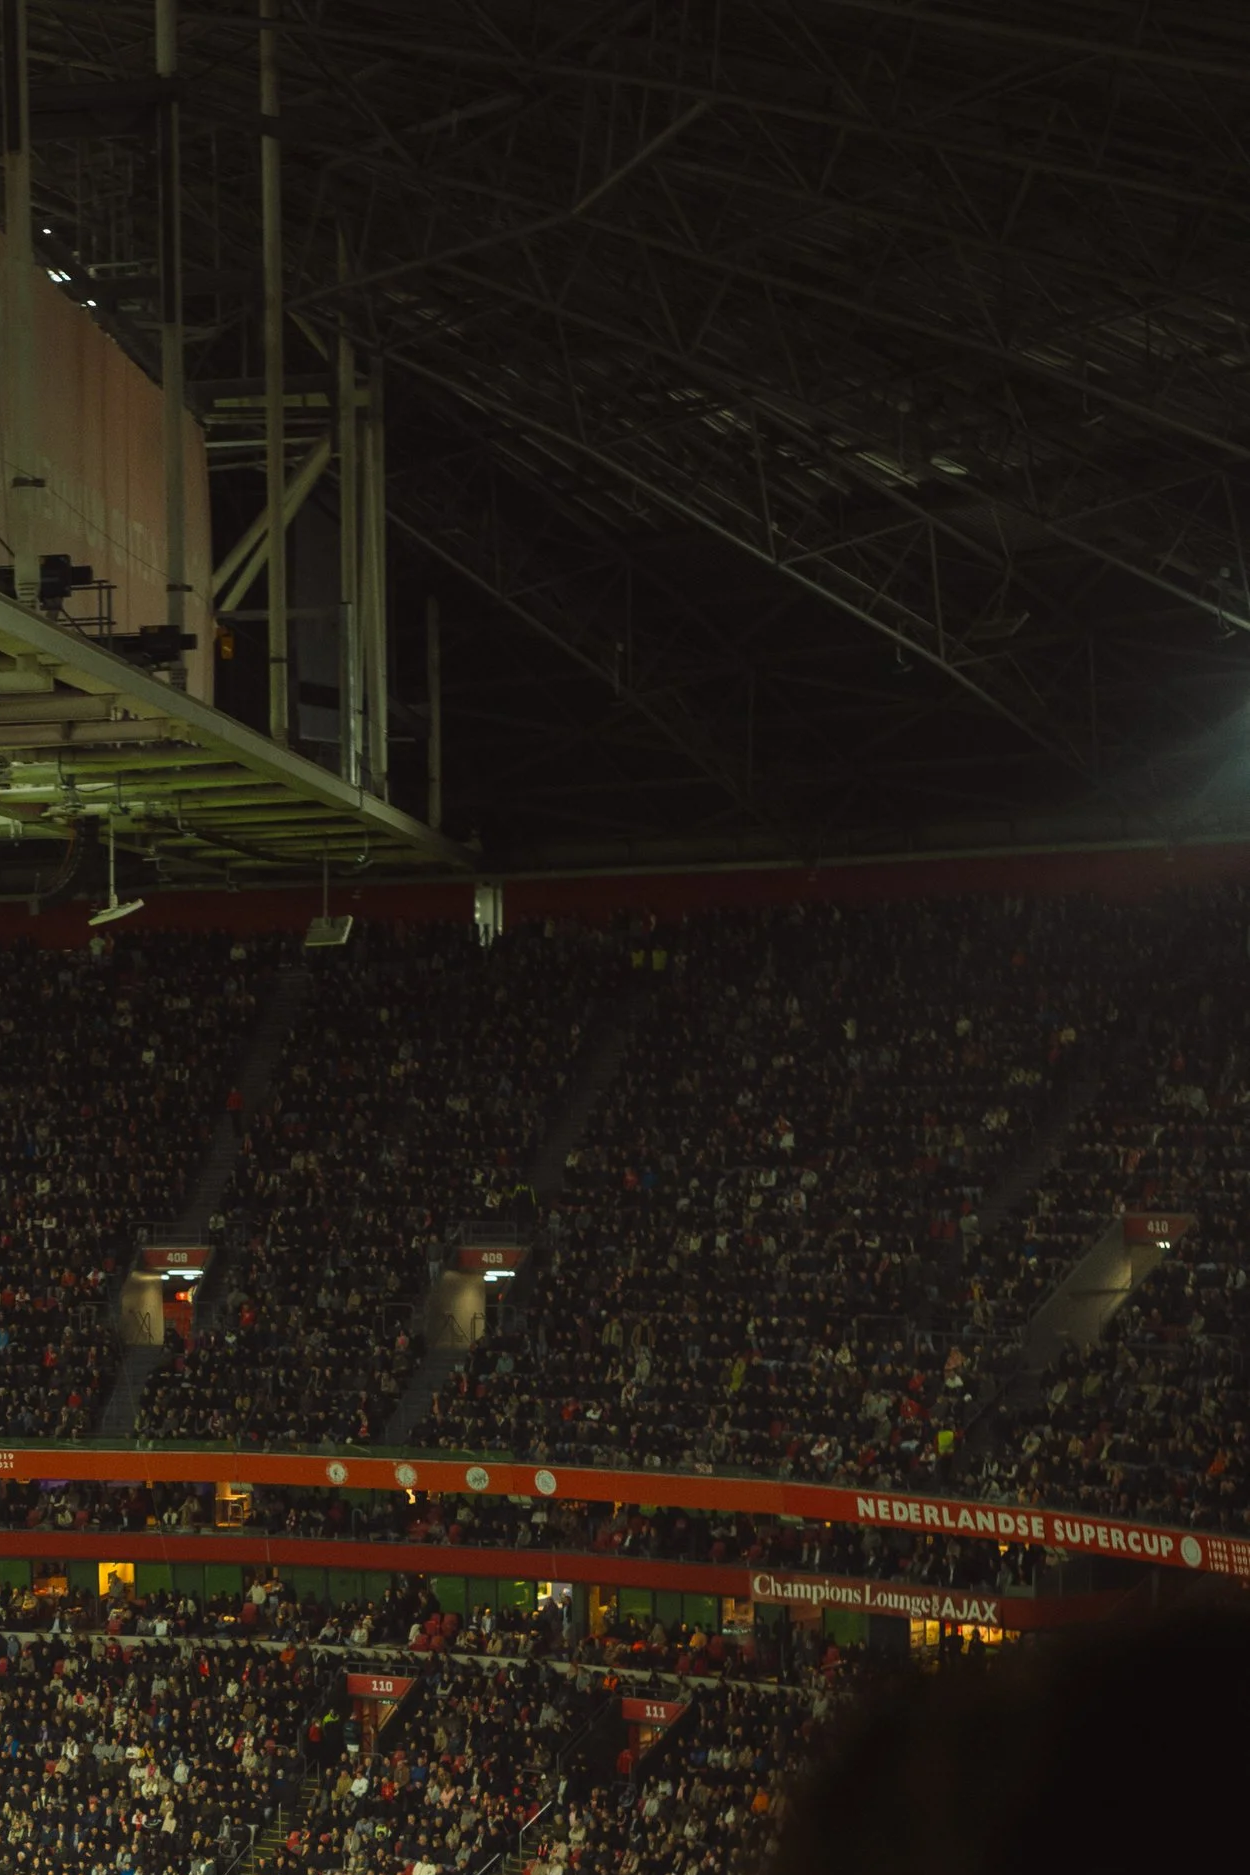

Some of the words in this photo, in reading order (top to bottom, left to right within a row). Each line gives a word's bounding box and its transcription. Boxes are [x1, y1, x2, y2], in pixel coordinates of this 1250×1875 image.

[857, 1496, 1045, 1539] NEDERLANDSE
[1053, 1518, 1174, 1558] SUPERCUP
[753, 1574, 862, 1606] Champions
[865, 1584, 931, 1618] Lounge
[942, 1597, 999, 1624] AJAX
[371, 1680, 393, 1692] 110
[645, 1704, 666, 1719] 111
